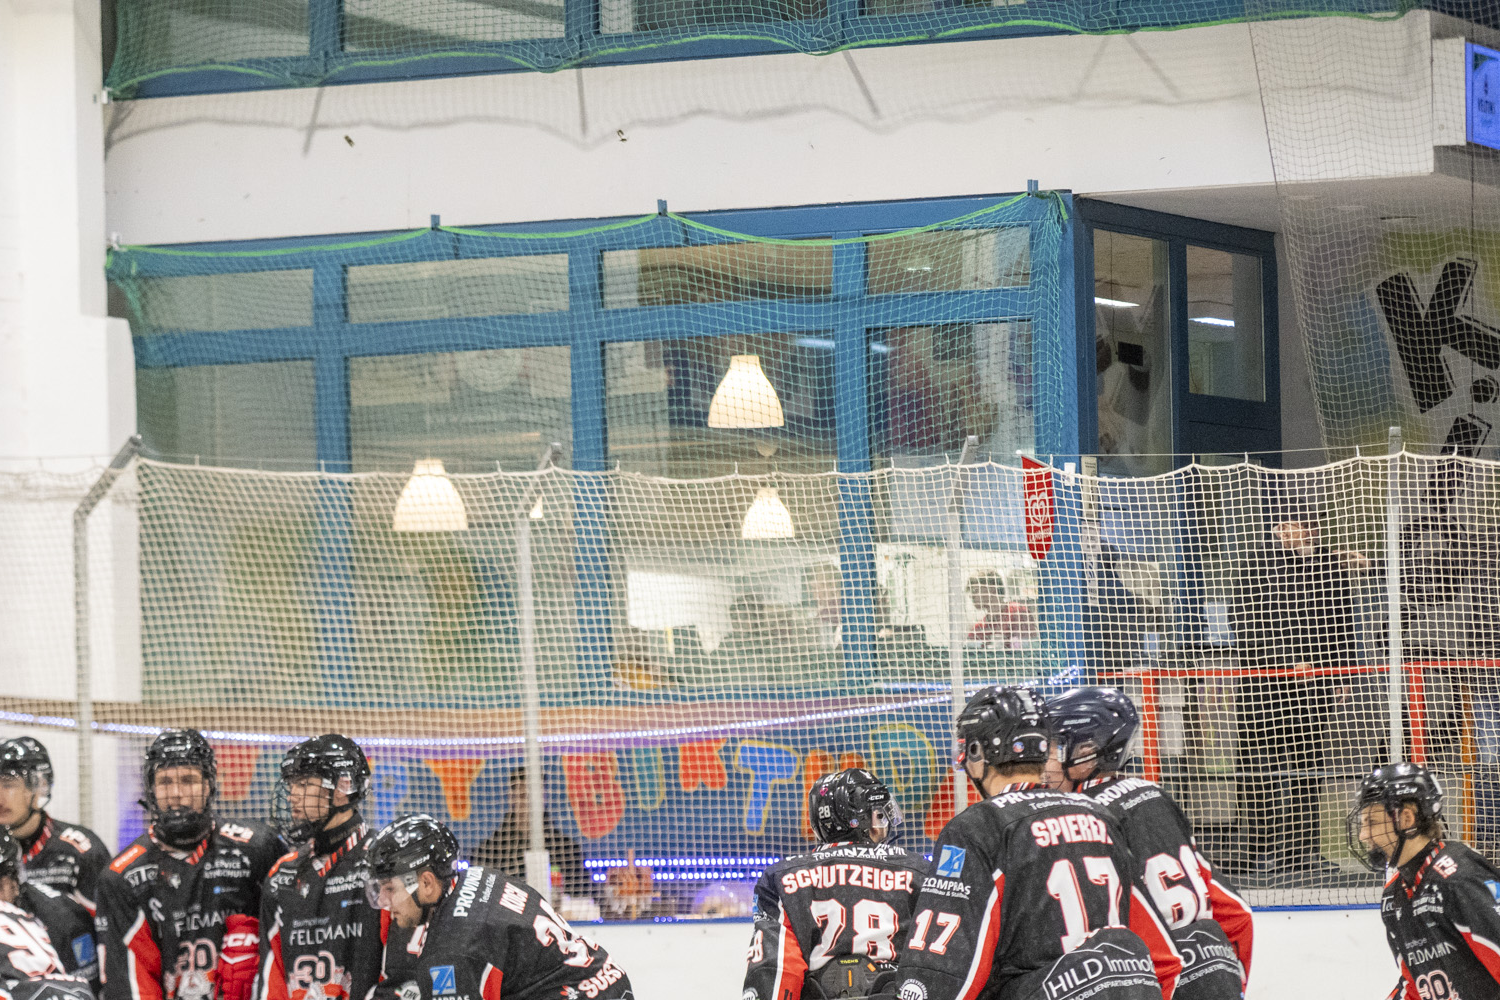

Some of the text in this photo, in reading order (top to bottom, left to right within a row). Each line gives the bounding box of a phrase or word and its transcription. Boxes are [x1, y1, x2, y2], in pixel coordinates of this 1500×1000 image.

[818, 805, 831, 819] 28
[408, 855, 431, 869] CCM
[1046, 856, 1130, 955] 17
[908, 908, 962, 955] 17
[1048, 958, 1104, 1000] HILD
